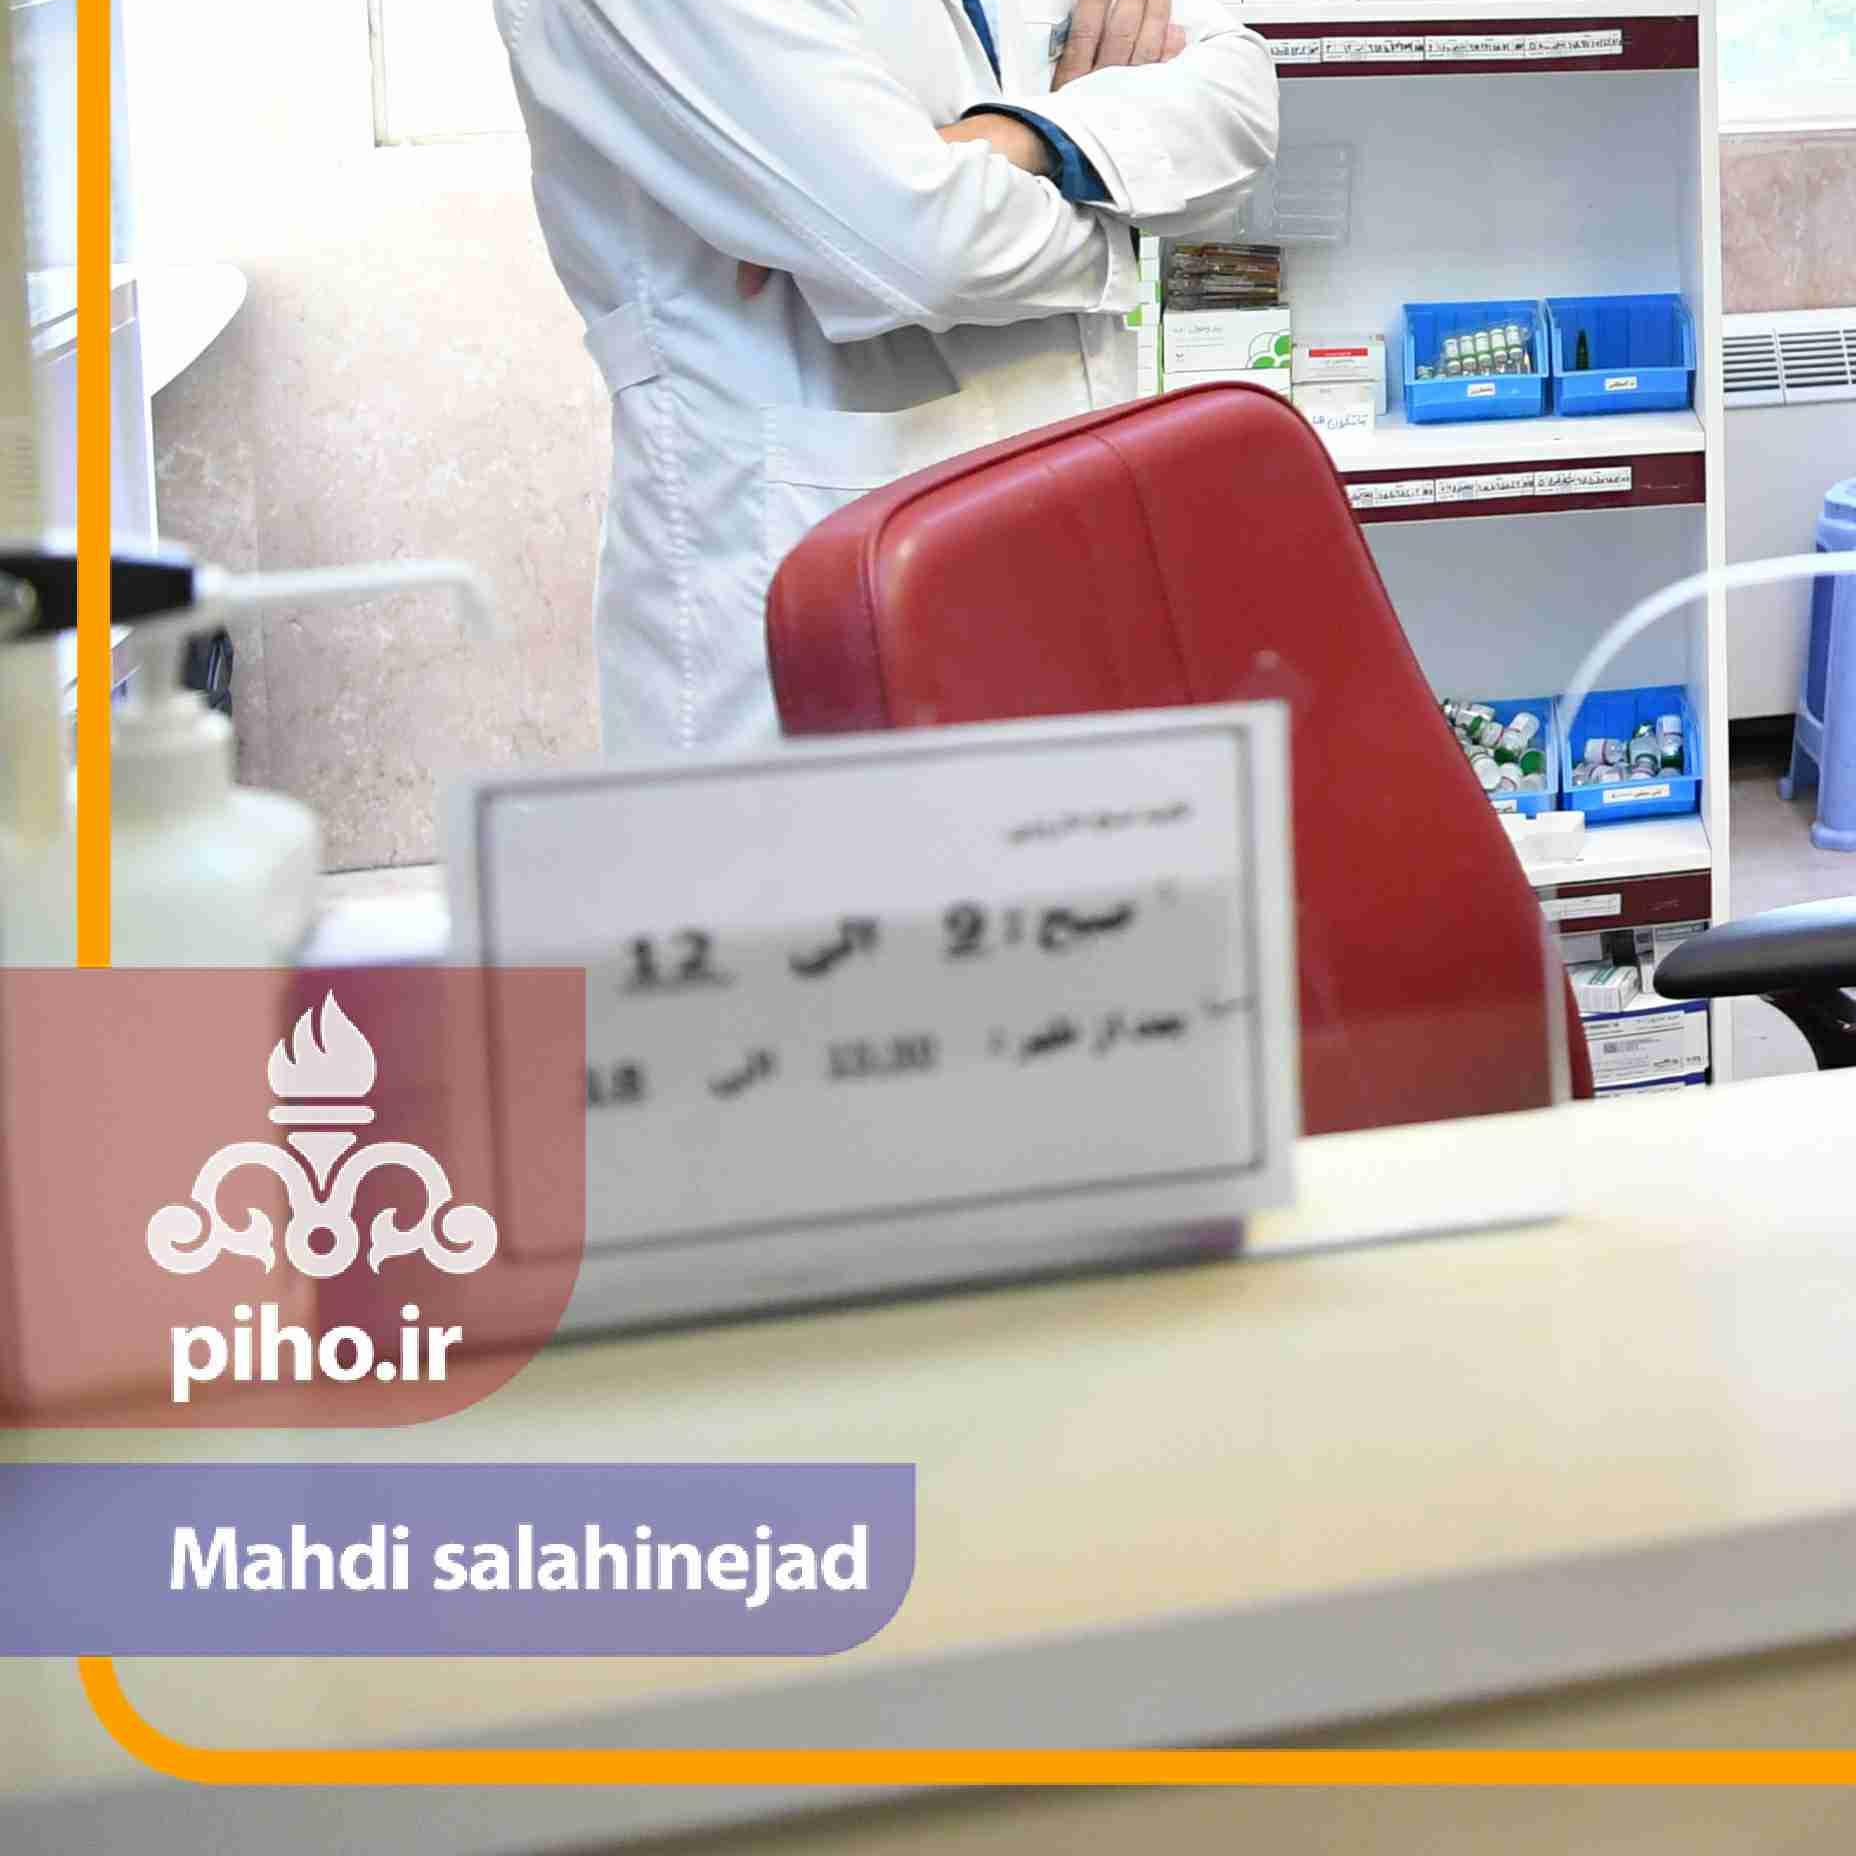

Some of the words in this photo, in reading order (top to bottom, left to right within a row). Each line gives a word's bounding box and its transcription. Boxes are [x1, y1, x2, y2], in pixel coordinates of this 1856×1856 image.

[619, 926, 735, 996] 12
[787, 914, 881, 981] الی
[708, 1047, 779, 1100] الی
